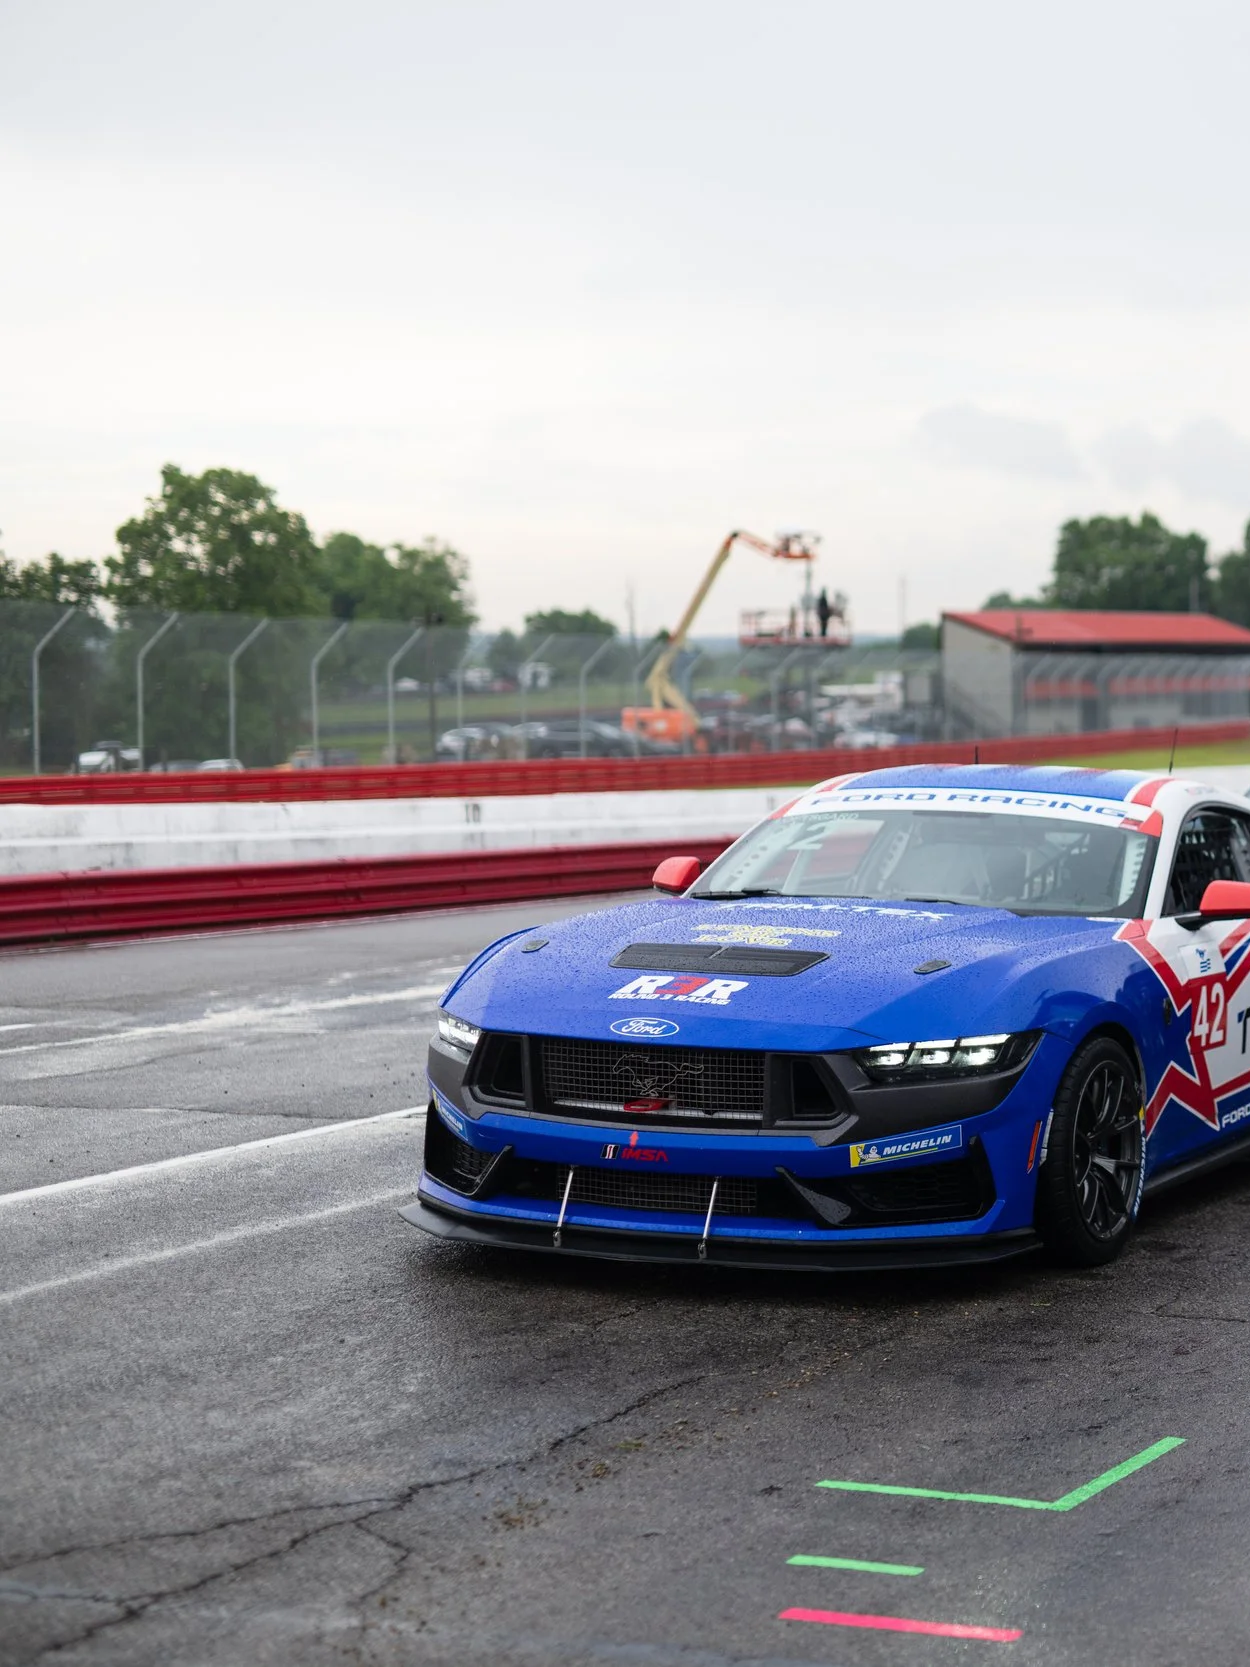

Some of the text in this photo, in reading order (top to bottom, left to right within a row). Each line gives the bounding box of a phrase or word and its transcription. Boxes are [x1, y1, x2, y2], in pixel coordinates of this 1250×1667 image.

[811, 793, 1129, 818] FORD RACING
[616, 975, 749, 999] R3R
[674, 995, 731, 1006] RACING
[1193, 982, 1225, 1048] 42
[621, 1019, 668, 1035] Ford
[882, 1134, 953, 1156] MICHELIN
